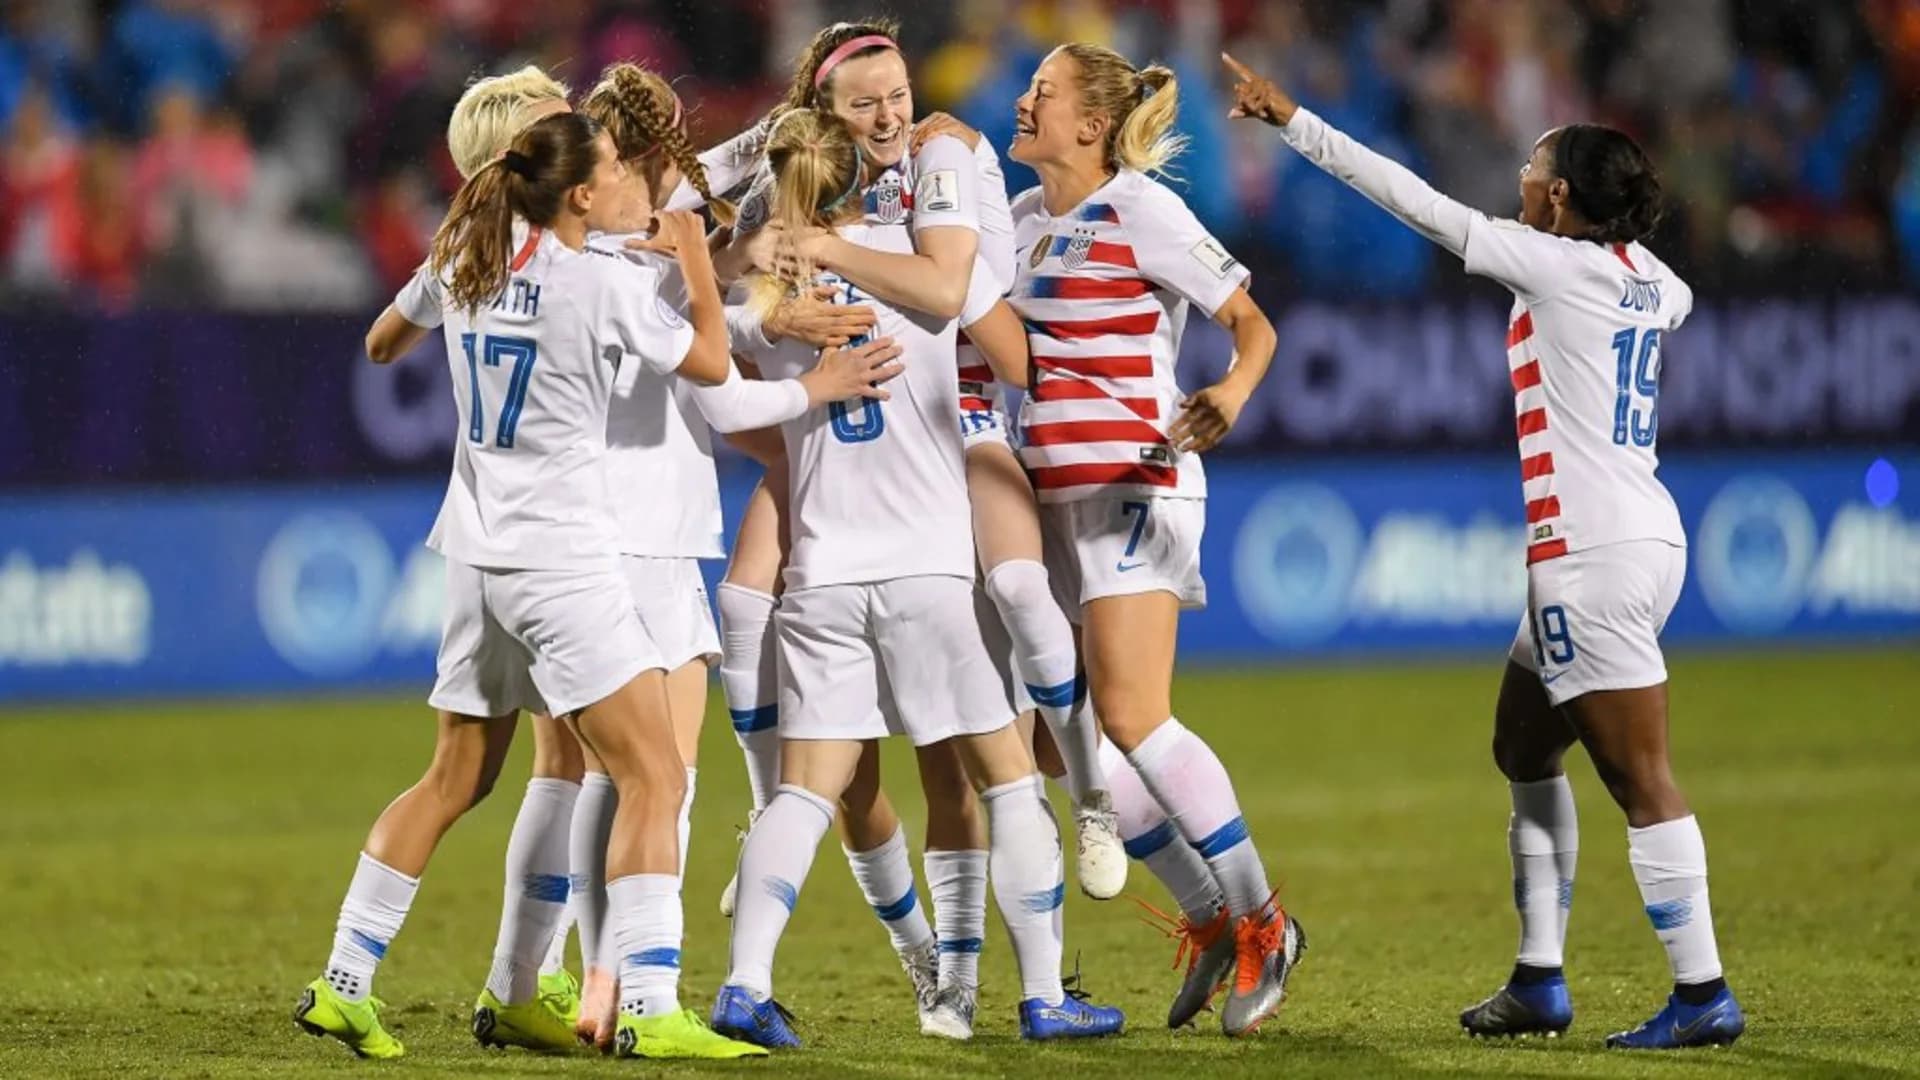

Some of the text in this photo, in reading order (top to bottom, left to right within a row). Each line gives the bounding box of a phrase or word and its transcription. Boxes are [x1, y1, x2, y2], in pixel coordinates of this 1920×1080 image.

[461, 333, 537, 449] 17
[1611, 326, 1659, 447] 19
[1122, 501, 1149, 557] 7
[1532, 605, 1574, 666] 19
